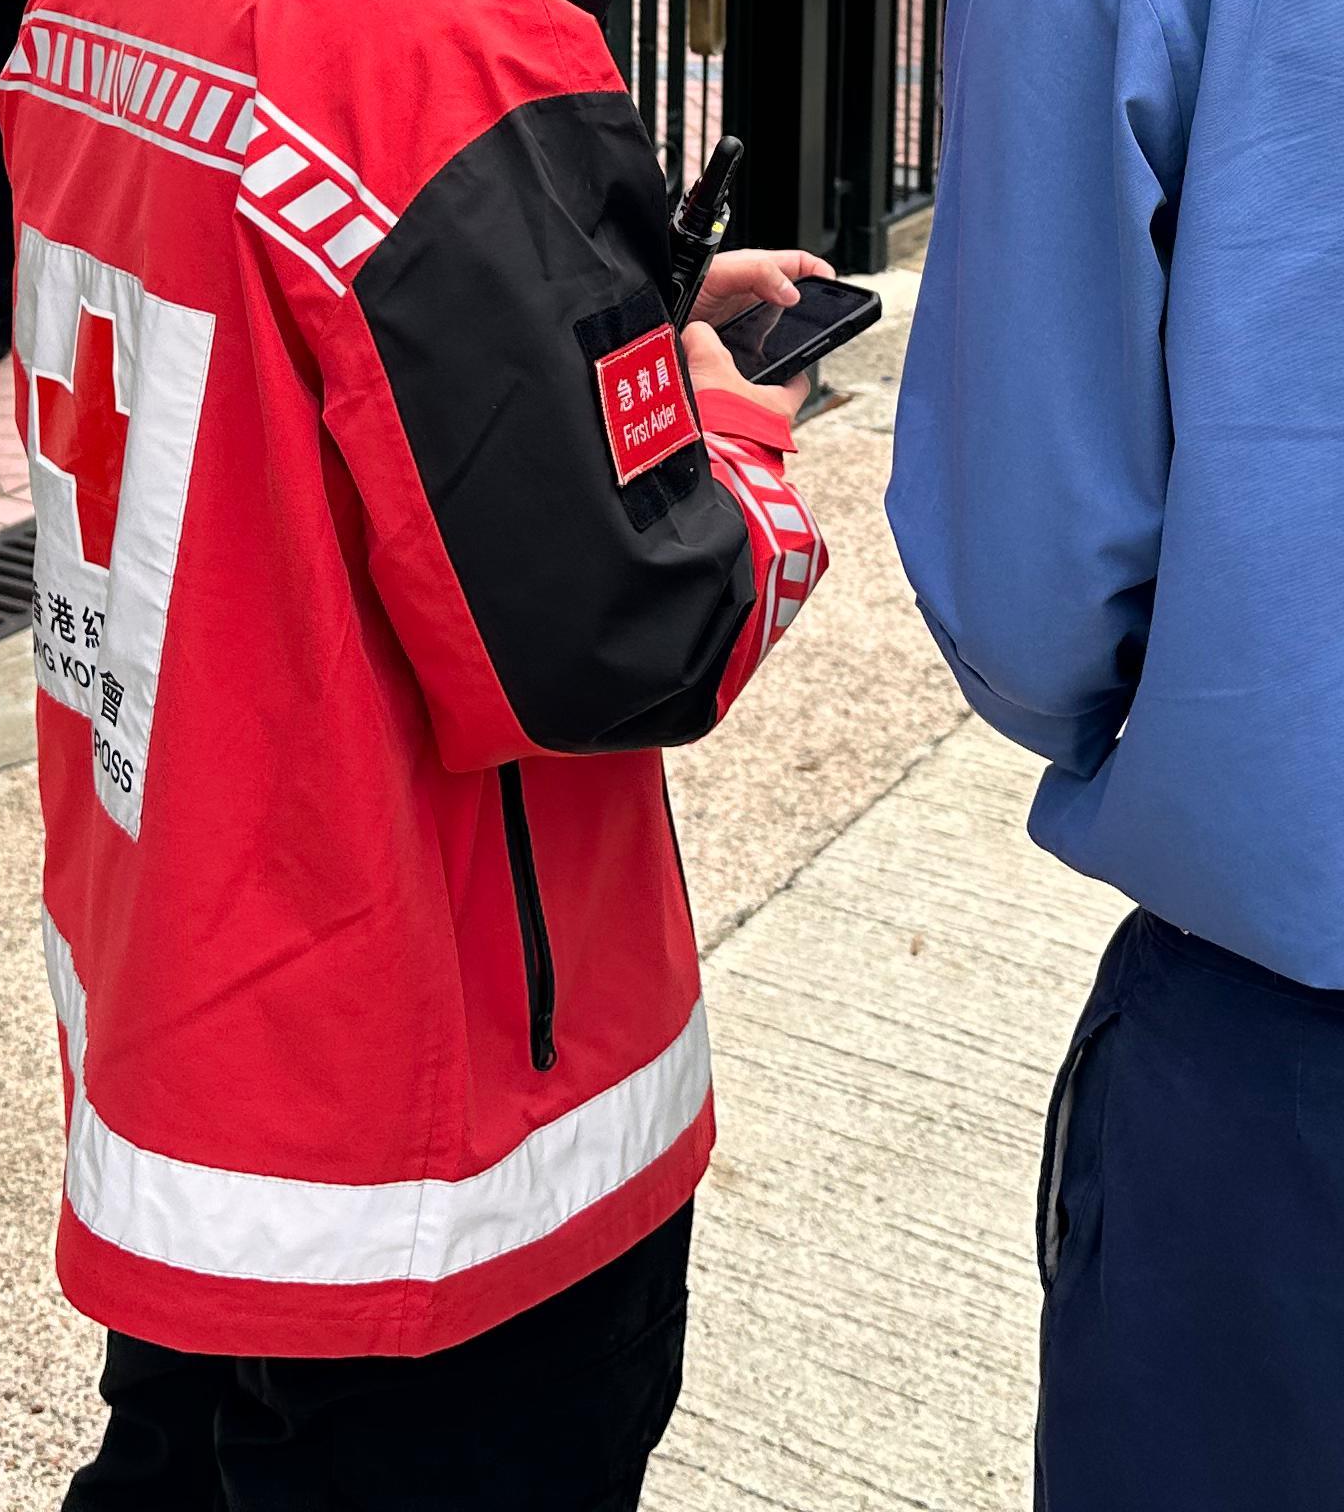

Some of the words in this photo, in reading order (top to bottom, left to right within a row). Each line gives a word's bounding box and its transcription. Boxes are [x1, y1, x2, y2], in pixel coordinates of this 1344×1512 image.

[617, 356, 671, 413] 急救員
[622, 416, 652, 451] First
[650, 403, 676, 437] Aider
